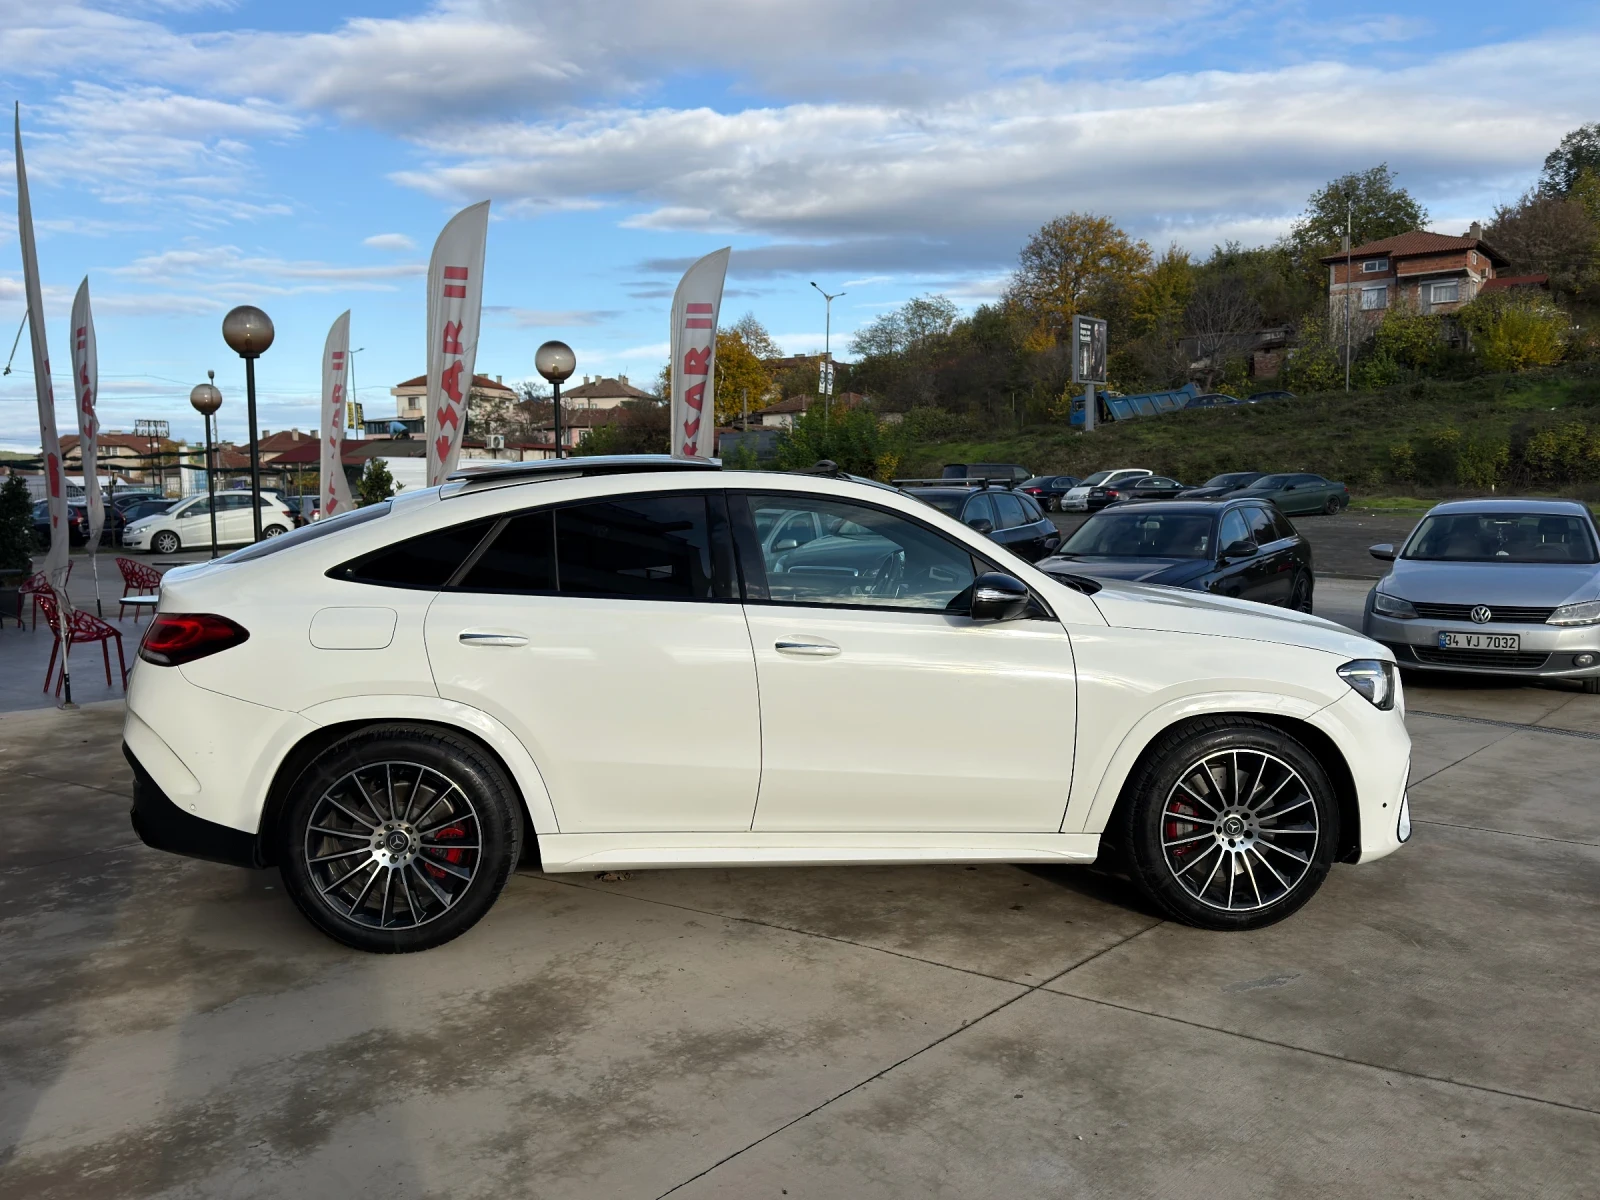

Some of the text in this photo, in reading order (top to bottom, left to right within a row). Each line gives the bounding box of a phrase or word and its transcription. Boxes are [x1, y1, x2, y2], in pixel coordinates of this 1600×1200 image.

[685, 303, 713, 329] II
[433, 266, 468, 486] ESAR II
[1446, 634, 1459, 646] 34
[1466, 635, 1480, 647] VJ
[1486, 636, 1516, 649] 7032
